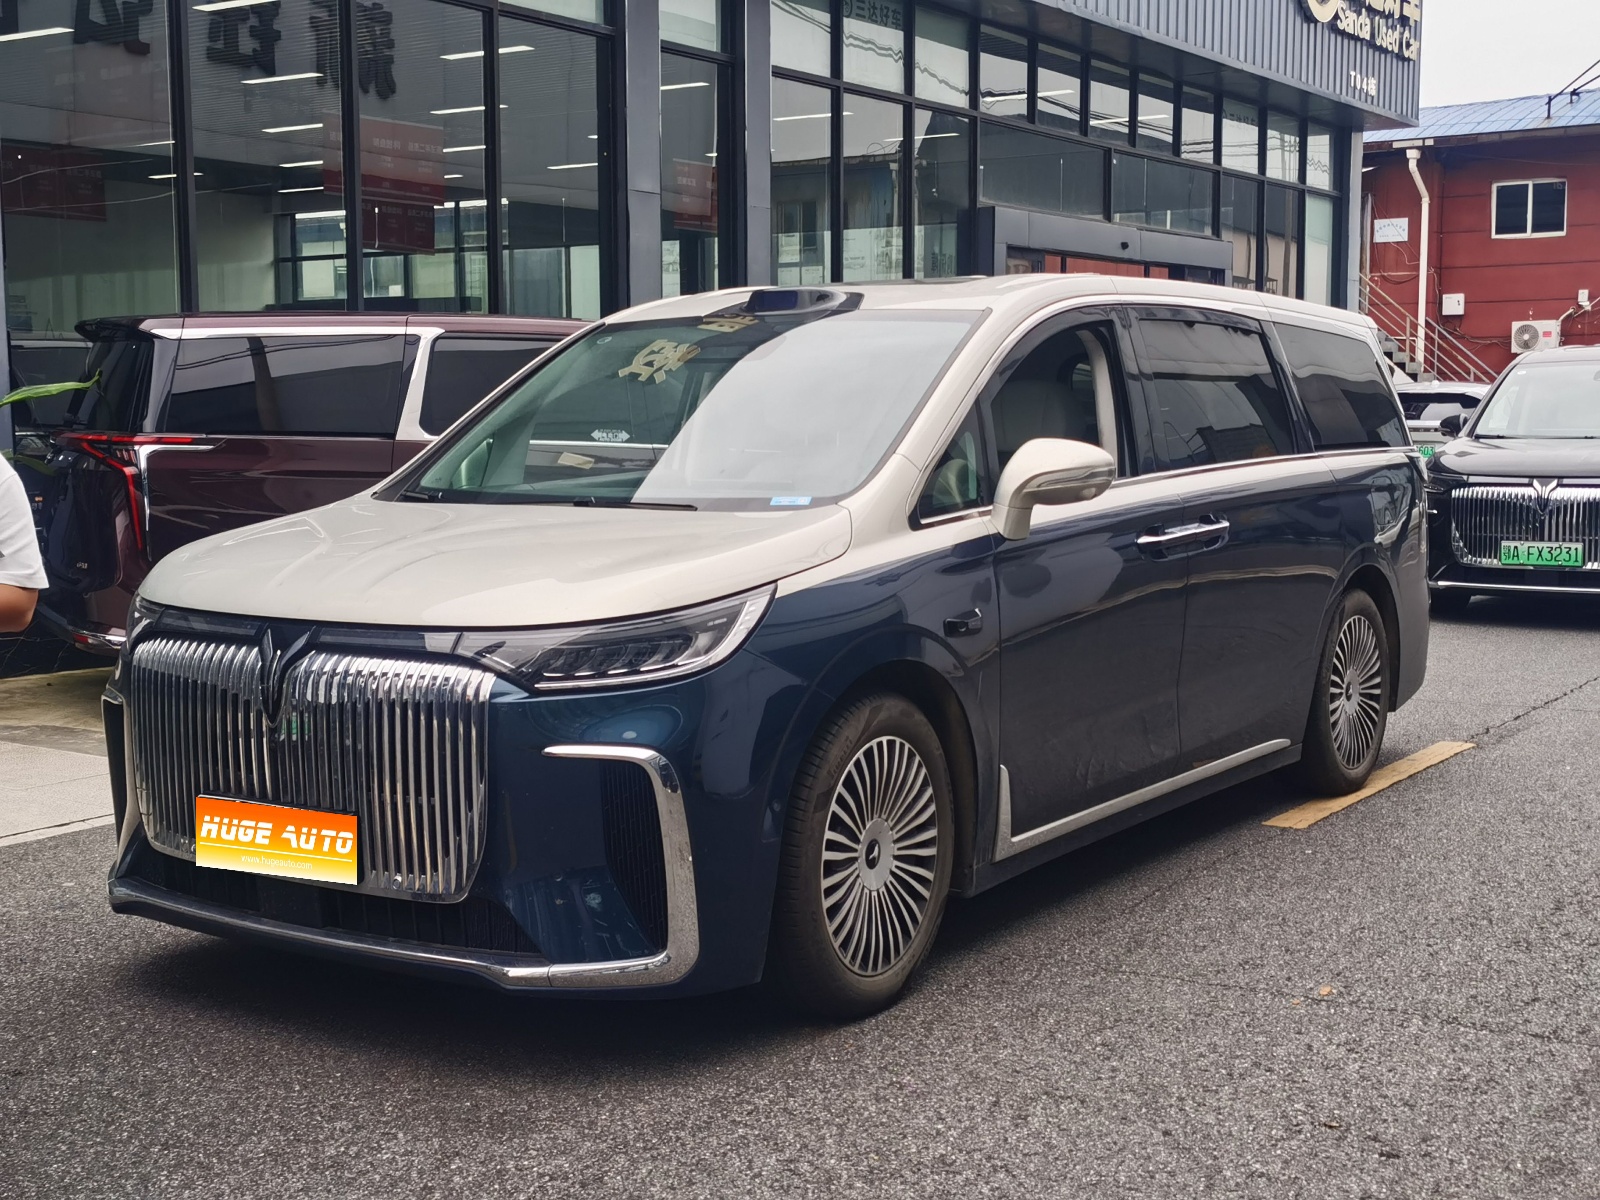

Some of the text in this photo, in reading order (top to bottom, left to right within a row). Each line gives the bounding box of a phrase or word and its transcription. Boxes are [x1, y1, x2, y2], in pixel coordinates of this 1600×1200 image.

[855, 0, 902, 29] 三达好车
[1337, 2, 1370, 40] Sanda
[1374, 15, 1400, 53] Used
[1527, 545, 1579, 563] FX3231
